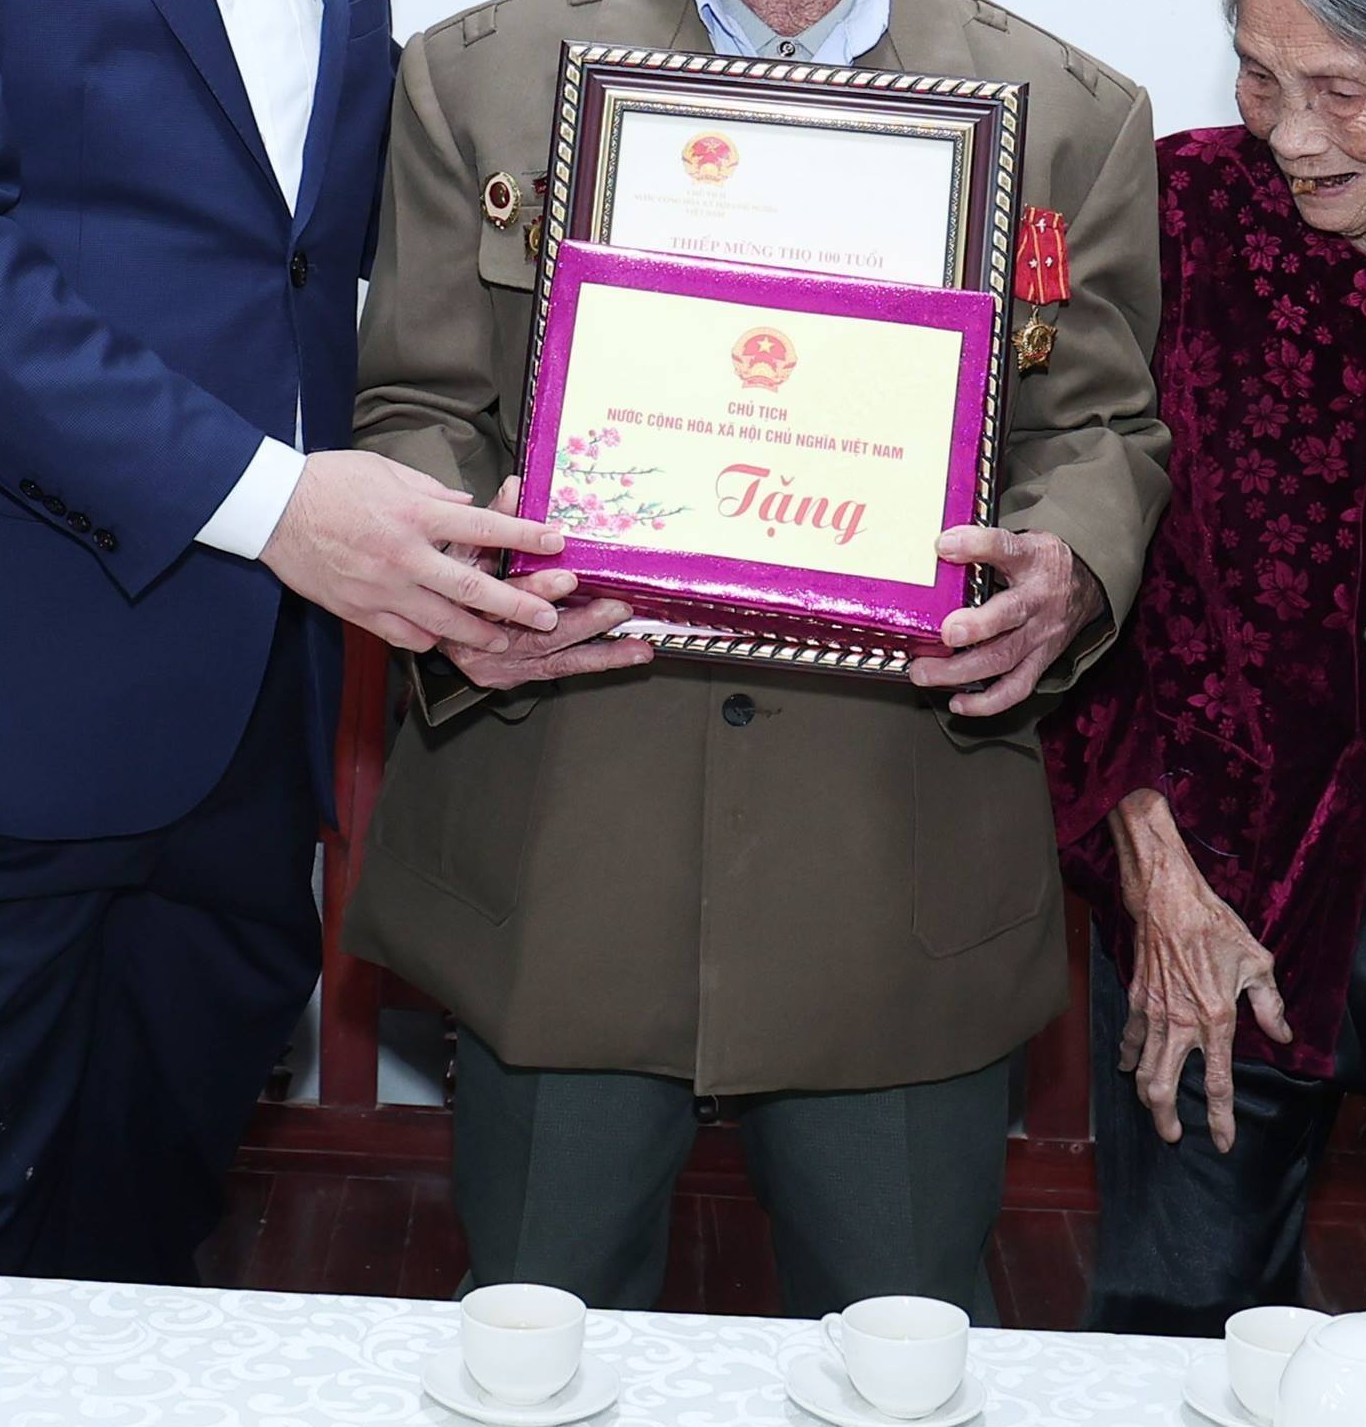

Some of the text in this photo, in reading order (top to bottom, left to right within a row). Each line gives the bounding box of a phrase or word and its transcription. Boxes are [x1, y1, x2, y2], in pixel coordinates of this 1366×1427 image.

[670, 233, 721, 253] THIẾP
[724, 239, 775, 259] MỪNG
[778, 245, 813, 264] THỌ
[818, 251, 841, 264] 100
[727, 399, 788, 423] CHỦ TỊCH
[606, 407, 905, 461] NƯỚC CỘNG HÒA XÃ HỘI CHỦ NGHĨA VIỆT NAM
[715, 463, 868, 546] Tặng
